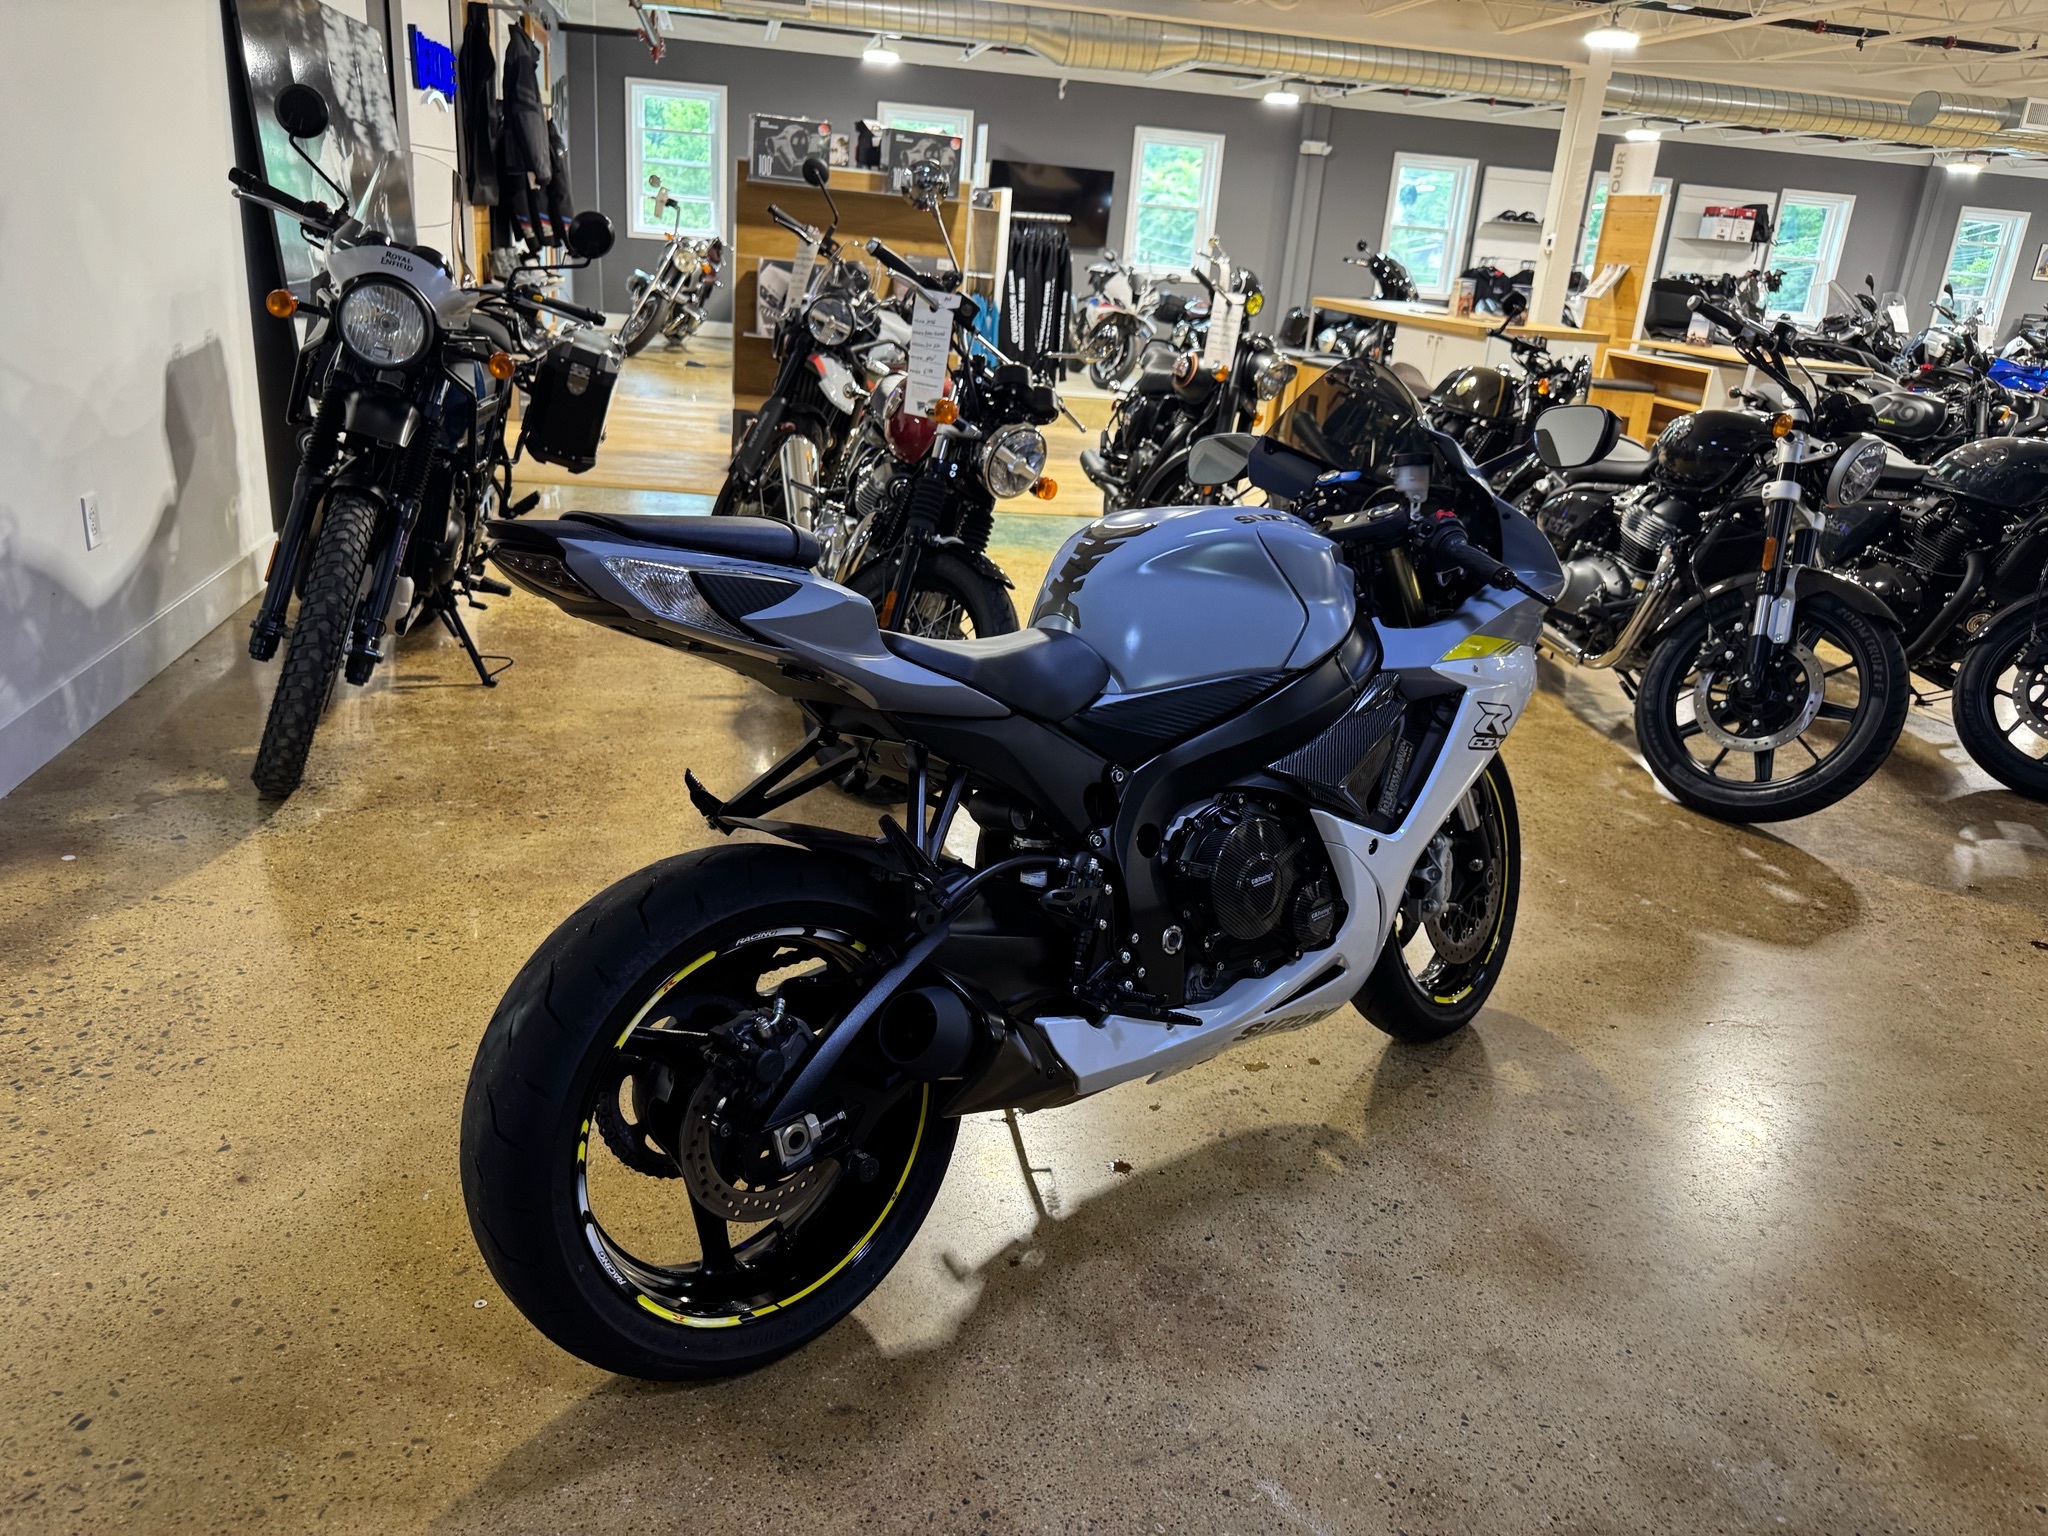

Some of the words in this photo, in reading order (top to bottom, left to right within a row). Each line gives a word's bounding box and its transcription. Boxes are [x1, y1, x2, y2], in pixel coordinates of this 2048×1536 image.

[758, 154, 773, 176] 100
[1611, 152, 1626, 193] OUR
[380, 256, 414, 272] ENFIELD
[385, 251, 412, 264] ROYAL
[735, 930, 778, 946] RACING
[598, 1251, 627, 1285] RACING
